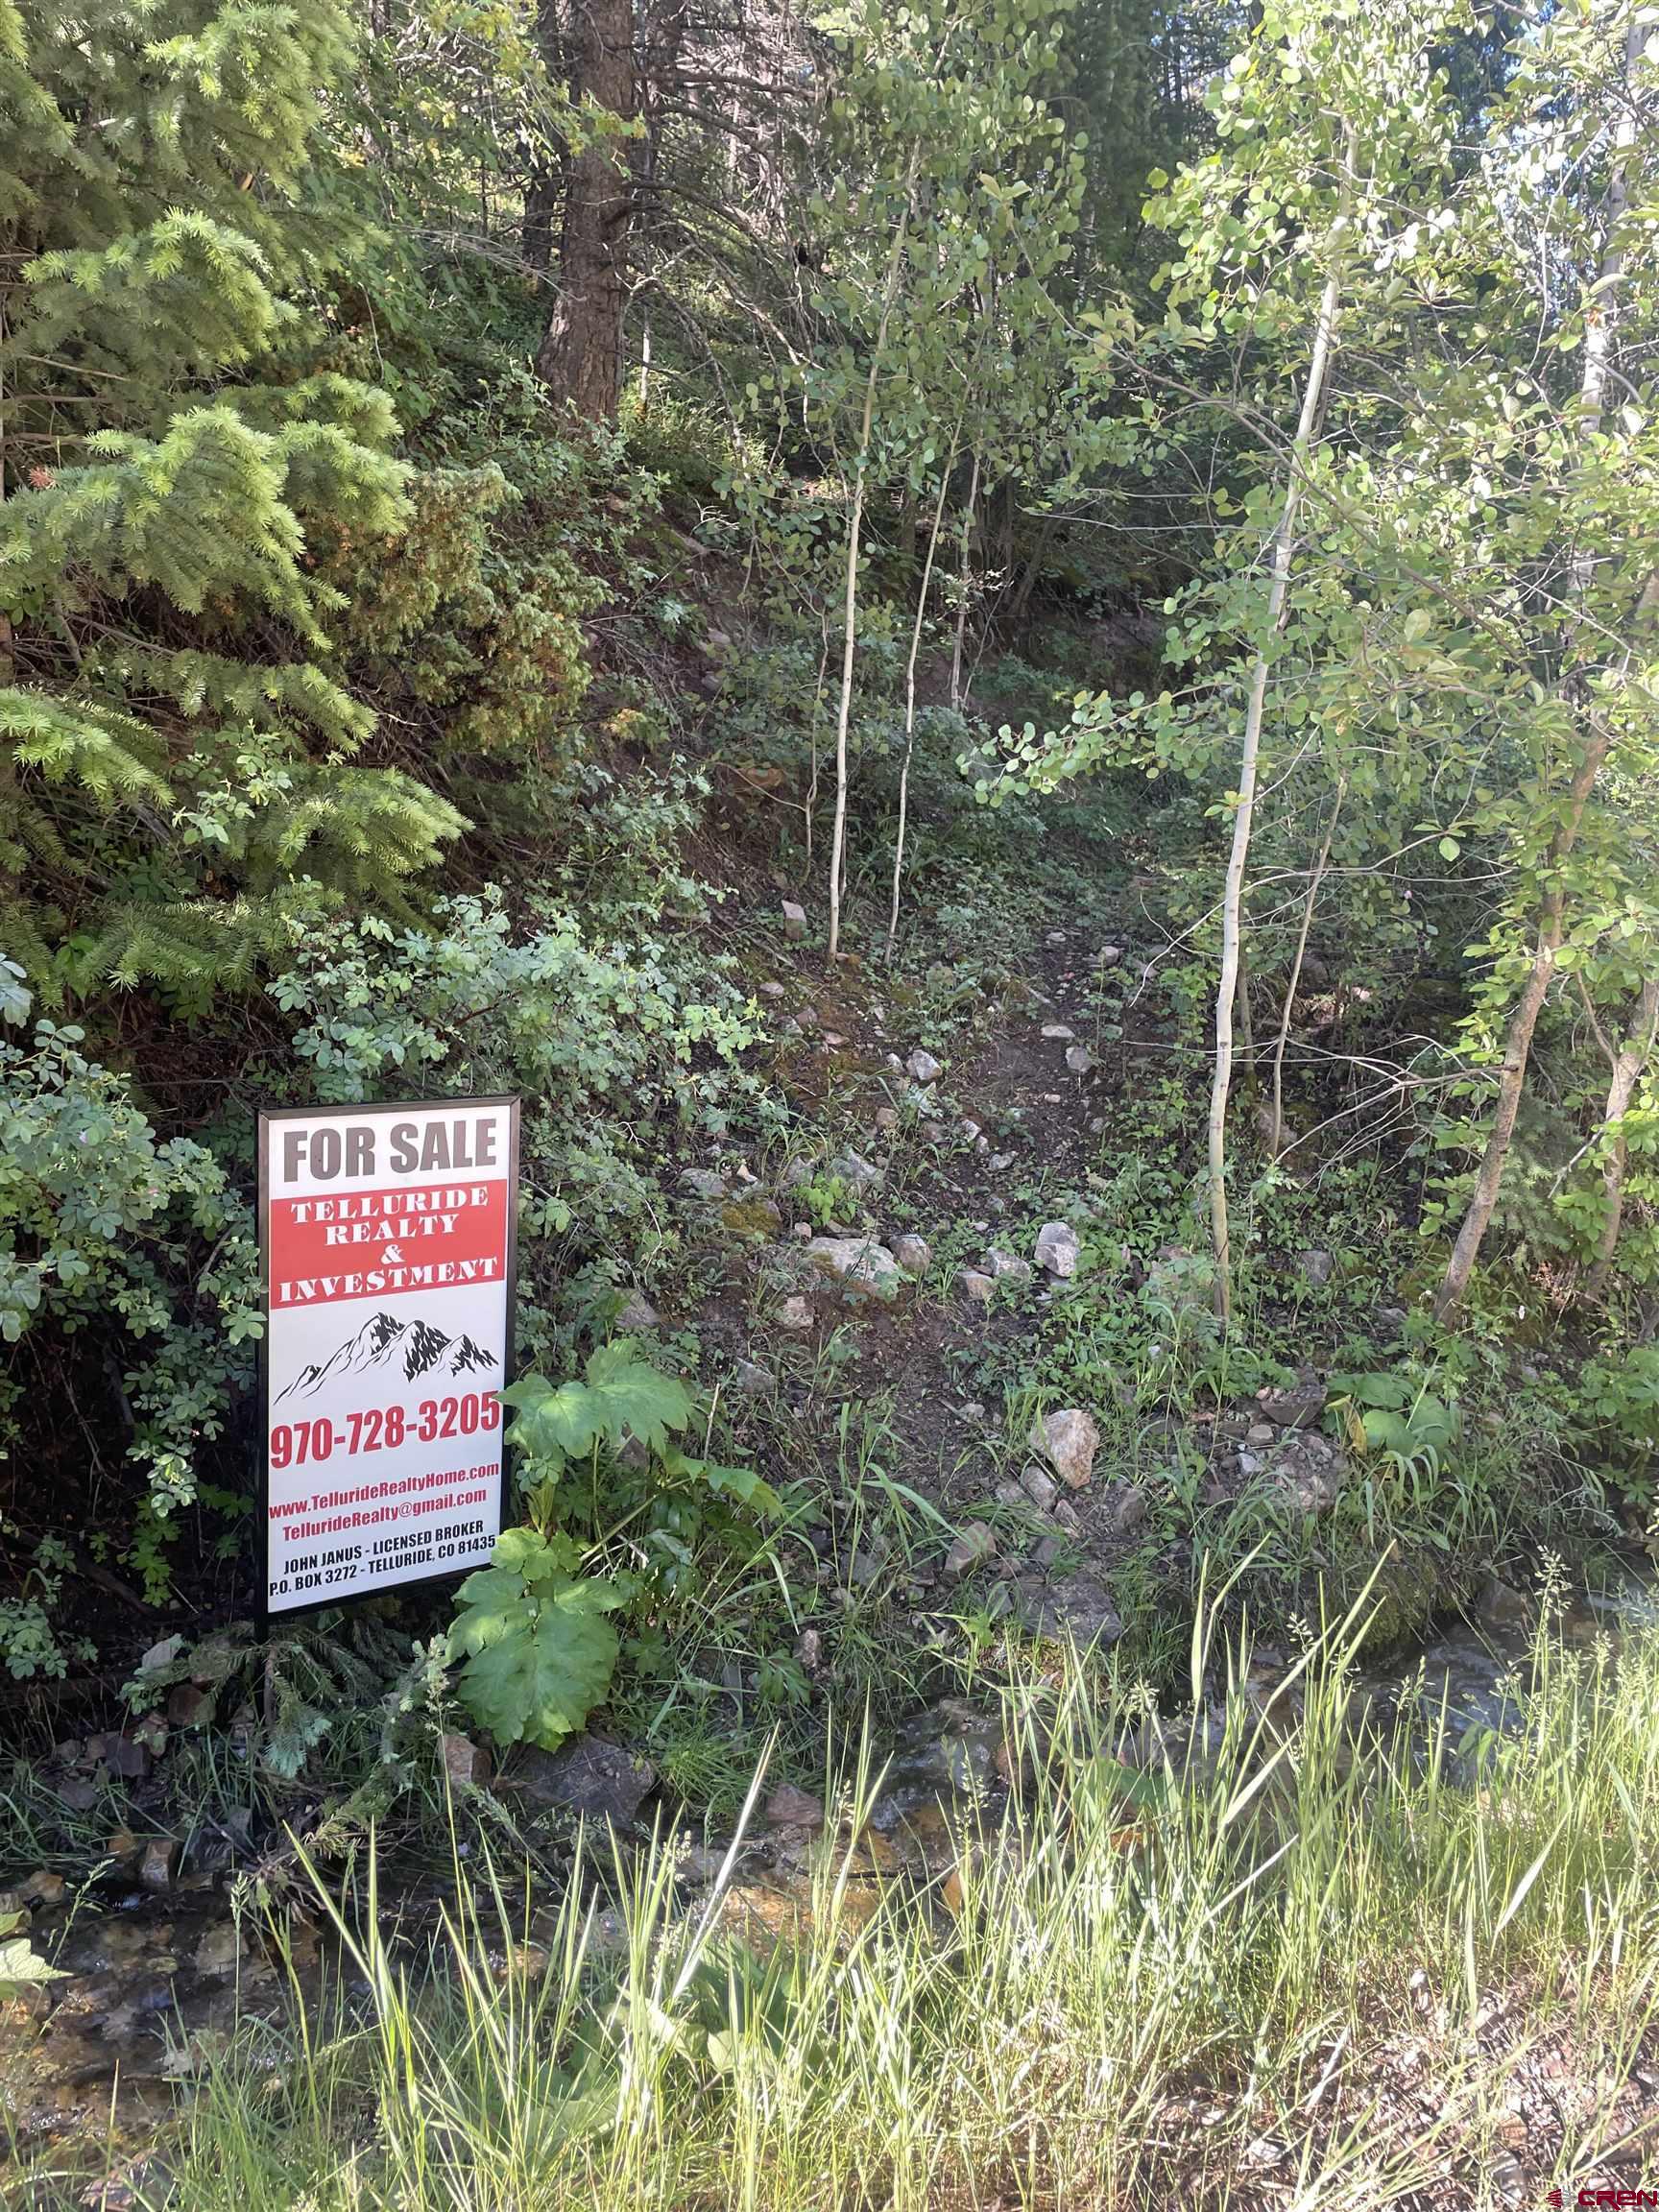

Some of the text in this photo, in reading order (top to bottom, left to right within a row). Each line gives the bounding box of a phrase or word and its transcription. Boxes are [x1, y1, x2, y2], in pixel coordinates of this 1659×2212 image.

[283, 1118, 497, 1183] FOR SALE
[291, 1186, 489, 1224] TELLURIDE
[325, 1214, 460, 1246] REALTY
[278, 1257, 498, 1303] INVESTMENT
[380, 1244, 406, 1264] &
[271, 1390, 500, 1469] 970-728-3205
[269, 1463, 499, 1519] www.TellurideRealtyHome.com
[282, 1489, 487, 1541] TellurideRealty@gmail.com
[269, 1579, 292, 1597] P.O.
[295, 1572, 323, 1591] BOX
[325, 1564, 357, 1584] 3272
[368, 1549, 436, 1574] TELLURIDE,
[438, 1543, 455, 1559] CO
[458, 1534, 496, 1554] 81435
[283, 1554, 318, 1575] JOHN
[321, 1545, 362, 1567] JANUS
[373, 1530, 432, 1554] LICENSED
[435, 1520, 484, 1542] BROKER
